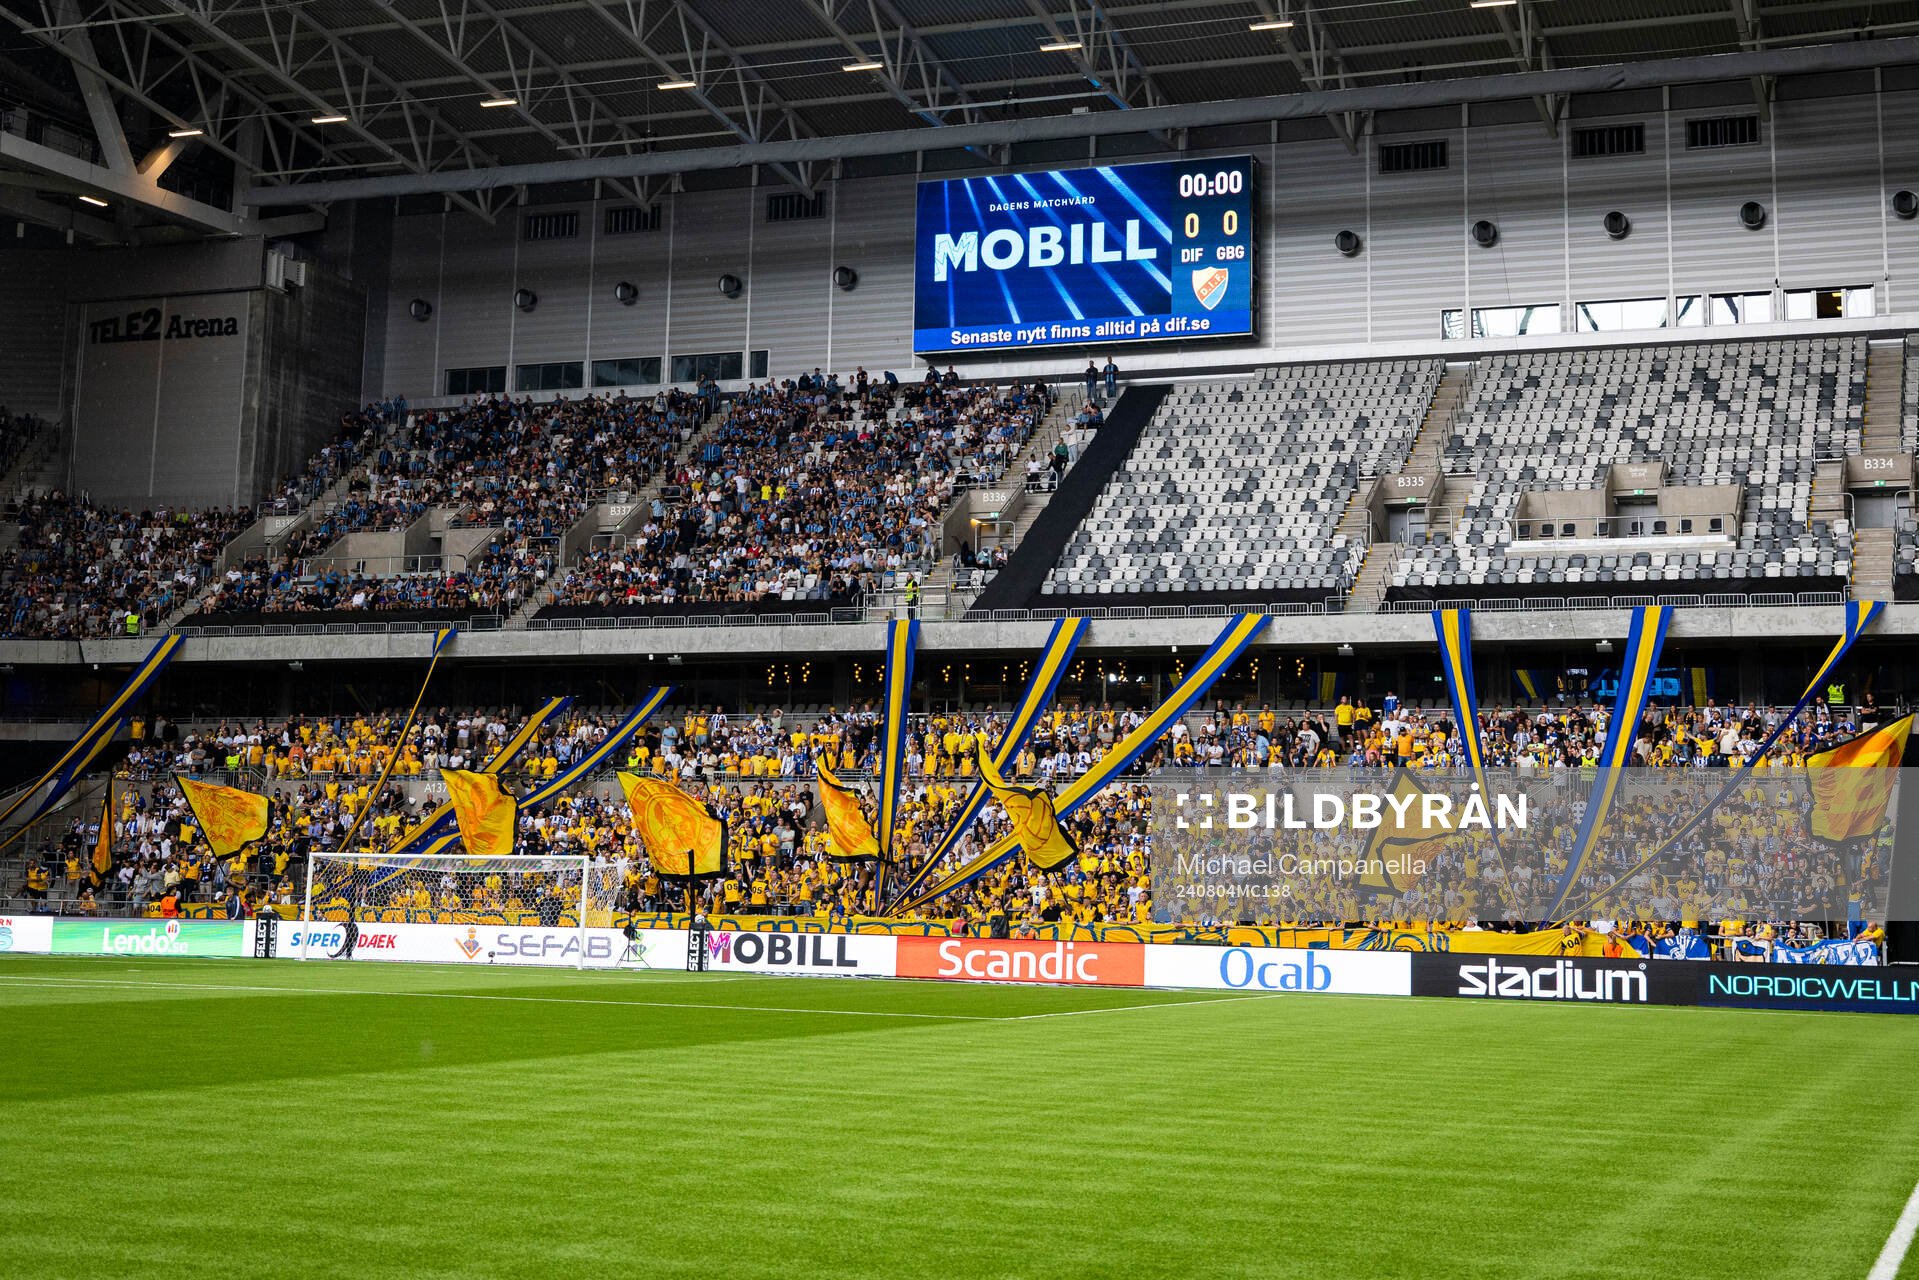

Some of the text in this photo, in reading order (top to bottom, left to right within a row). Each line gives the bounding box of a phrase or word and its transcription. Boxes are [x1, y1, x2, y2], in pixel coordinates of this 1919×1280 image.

[1179, 171, 1243, 197] 00:00
[989, 202, 1030, 212] DAGENS
[1185, 210, 1238, 238] 0 0
[934, 219, 1157, 282] MOBILL
[1181, 245, 1245, 263] DIF GBG
[90, 308, 238, 344] TELE2 Arena
[950, 316, 1210, 345] Senaste nytt finns alltid på dif.se
[1863, 458, 1894, 470] B334
[1397, 476, 1425, 487] B335
[982, 492, 1007, 502] B336
[256, 919, 267, 958] SELECT
[496, 933, 612, 958] SEFAB
[688, 929, 700, 971] SELECT
[708, 931, 858, 968] MOBILL
[938, 940, 1098, 982] Scandic
[1219, 947, 1332, 990] Ocab
[1458, 957, 1647, 1001] stadium
